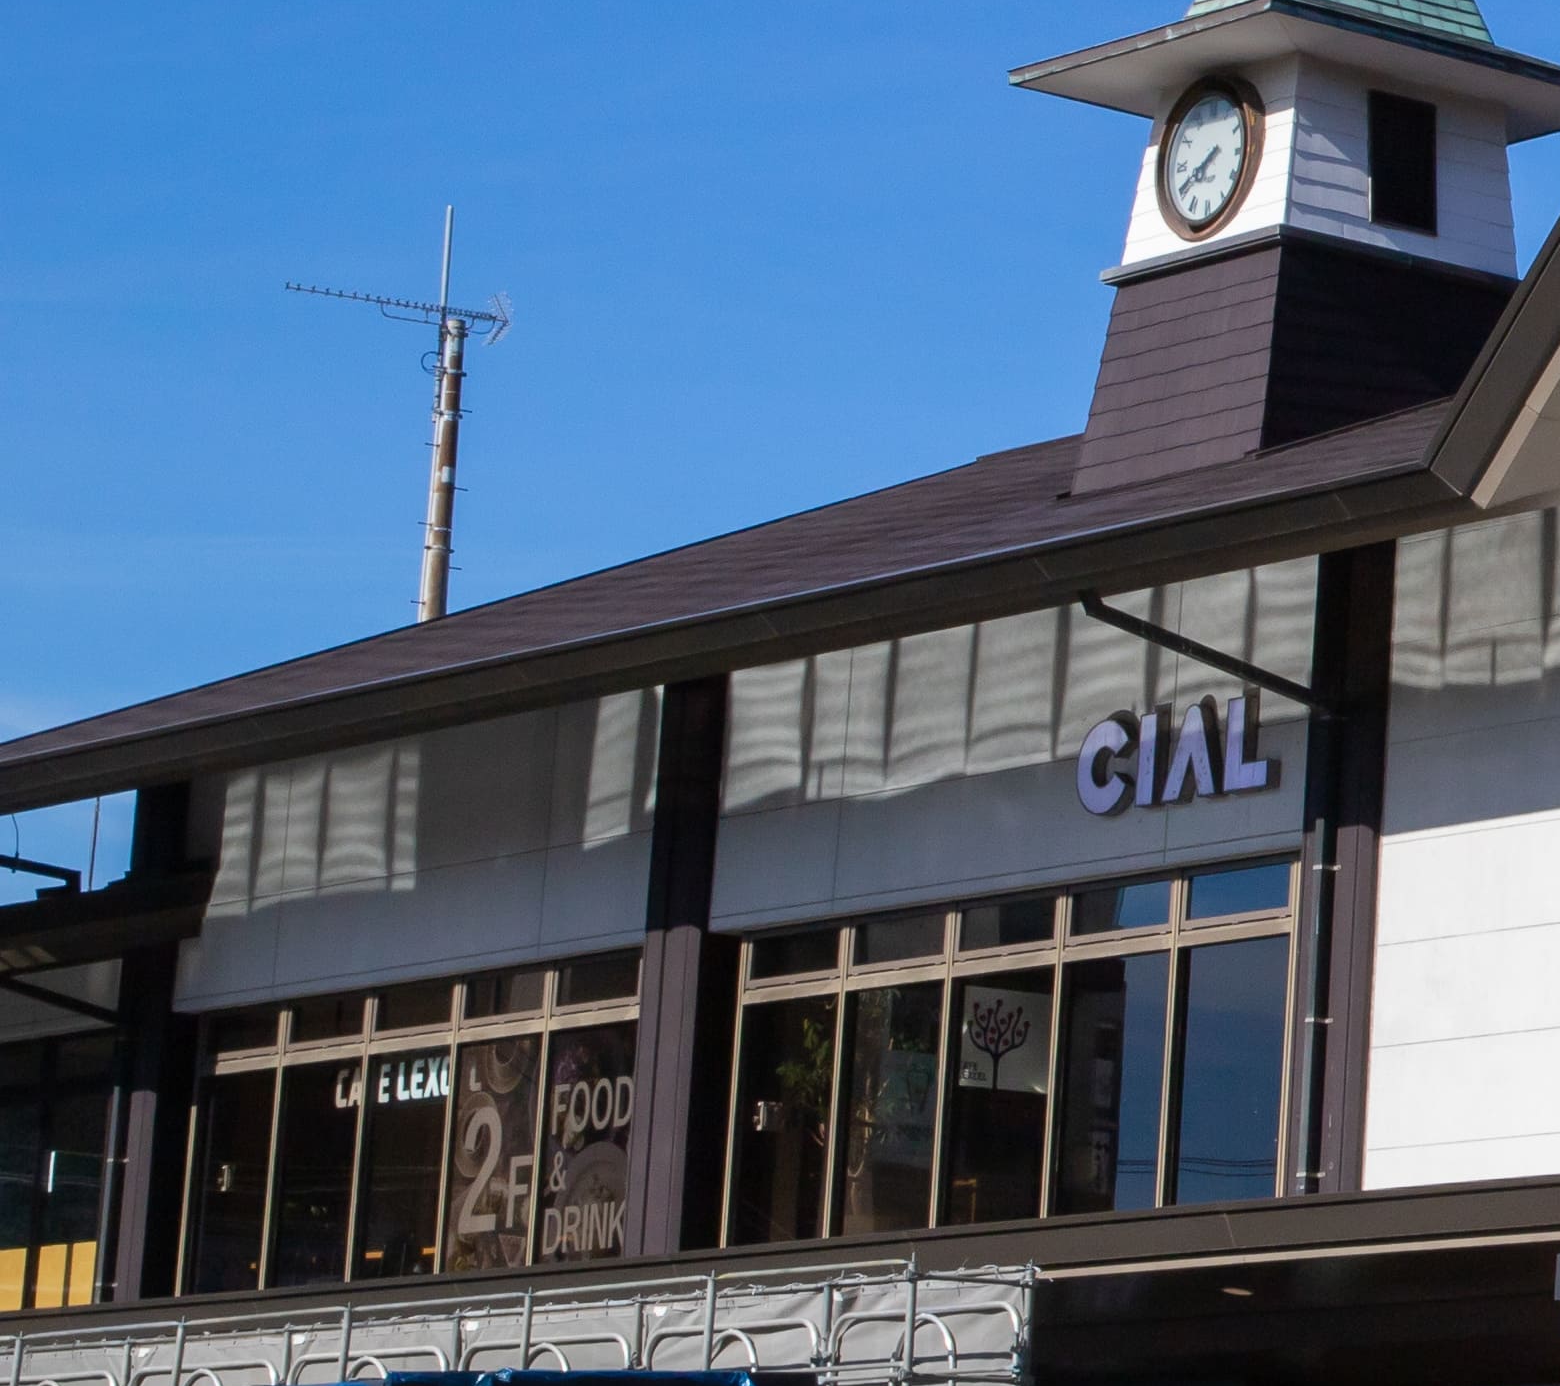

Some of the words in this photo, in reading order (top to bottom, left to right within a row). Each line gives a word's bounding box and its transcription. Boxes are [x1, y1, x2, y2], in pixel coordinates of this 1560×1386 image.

[1076, 694, 1275, 816] CIAL
[551, 1075, 635, 1136] FOOD
[457, 1105, 534, 1236] 2F
[549, 1151, 567, 1193] &
[541, 1201, 626, 1256] DRINK
